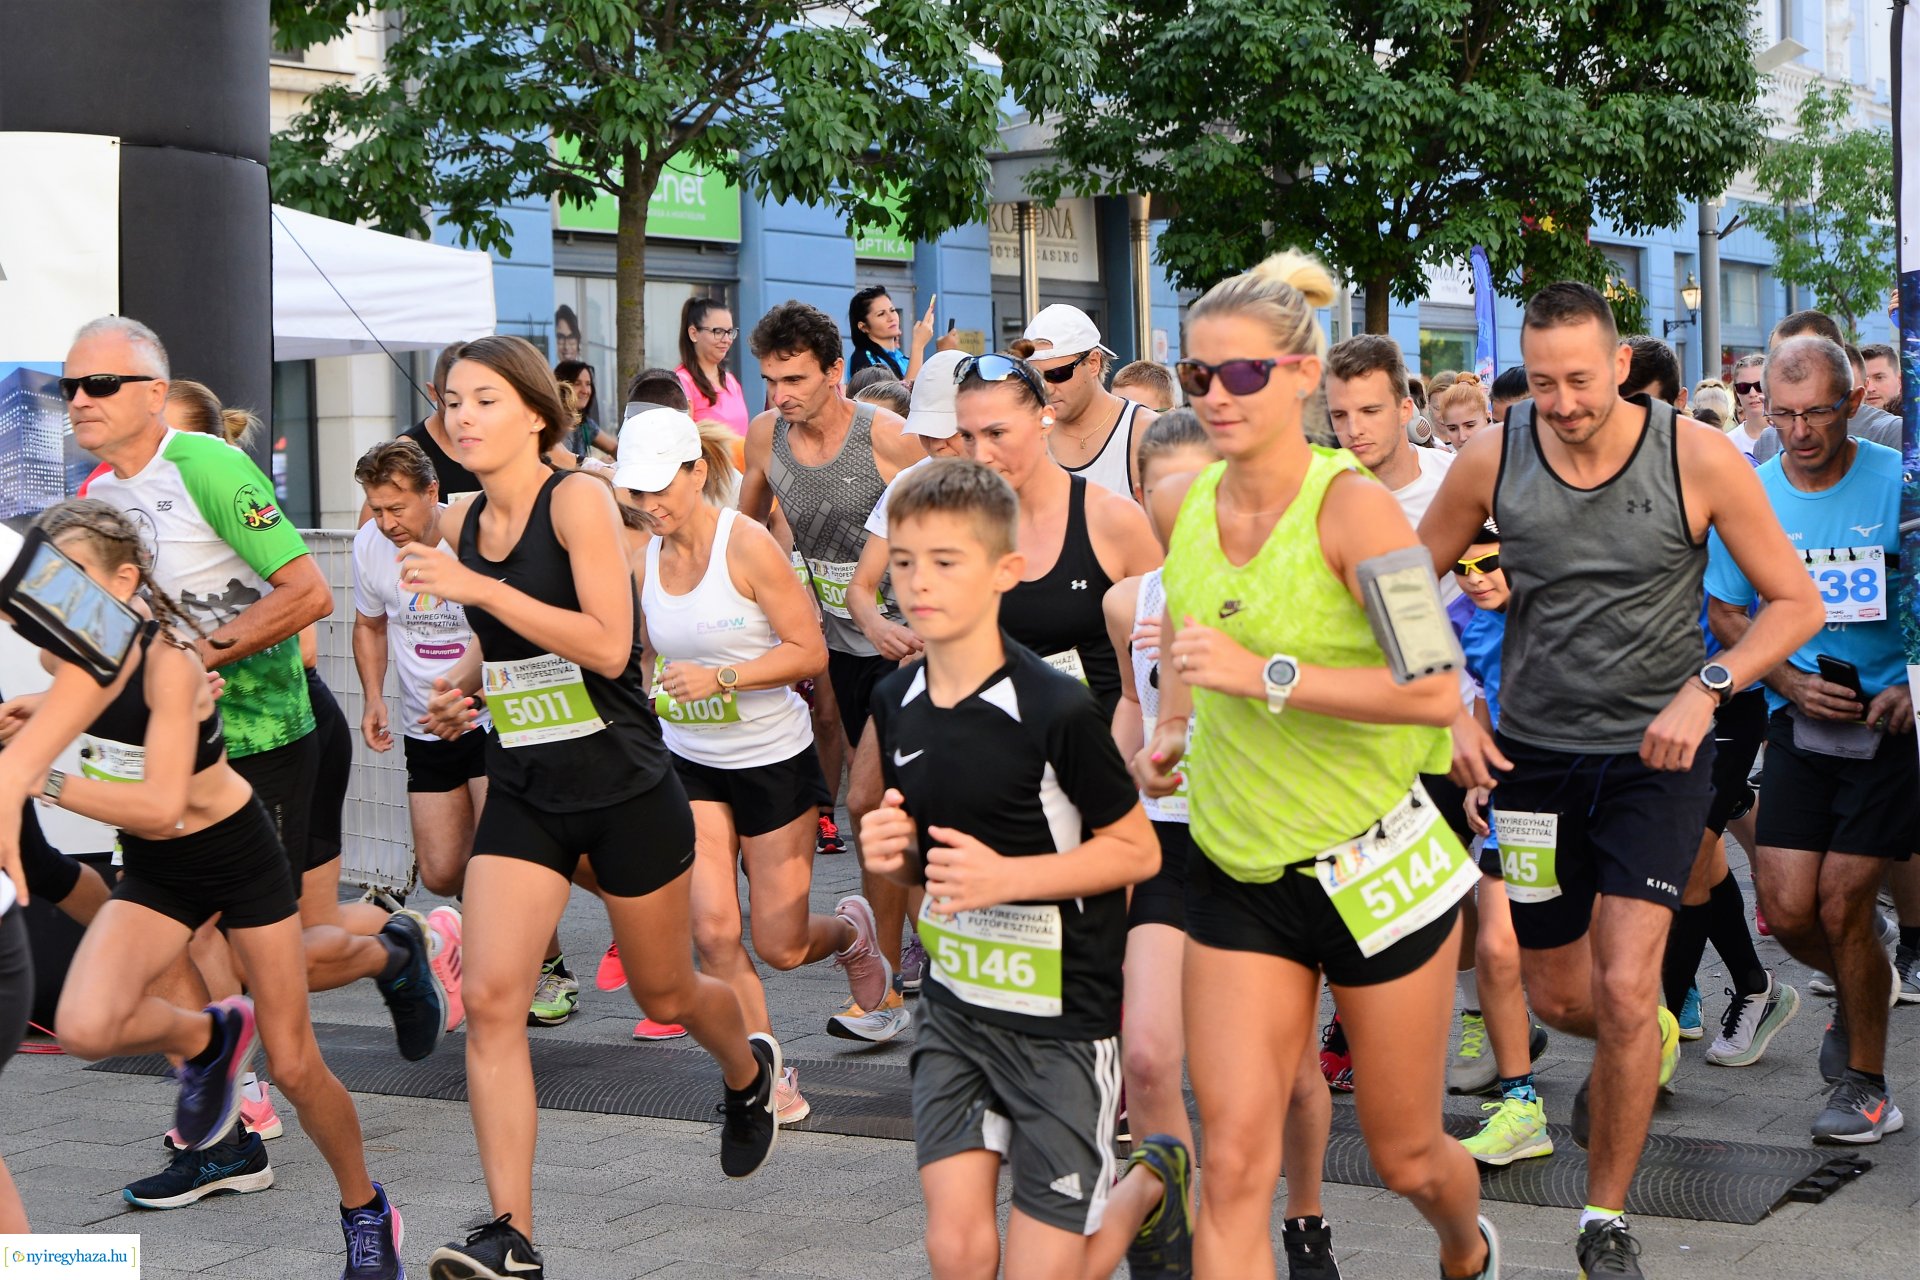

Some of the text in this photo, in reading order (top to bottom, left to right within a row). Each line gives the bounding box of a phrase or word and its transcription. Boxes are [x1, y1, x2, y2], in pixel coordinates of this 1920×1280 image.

[989, 203, 1077, 239] KOONA
[1037, 249, 1079, 263] ASINO
[1808, 568, 1878, 604] 38
[503, 690, 573, 726] 5011
[668, 697, 725, 721] 5100
[1359, 836, 1453, 919] 5144
[938, 936, 1036, 988] 5146
